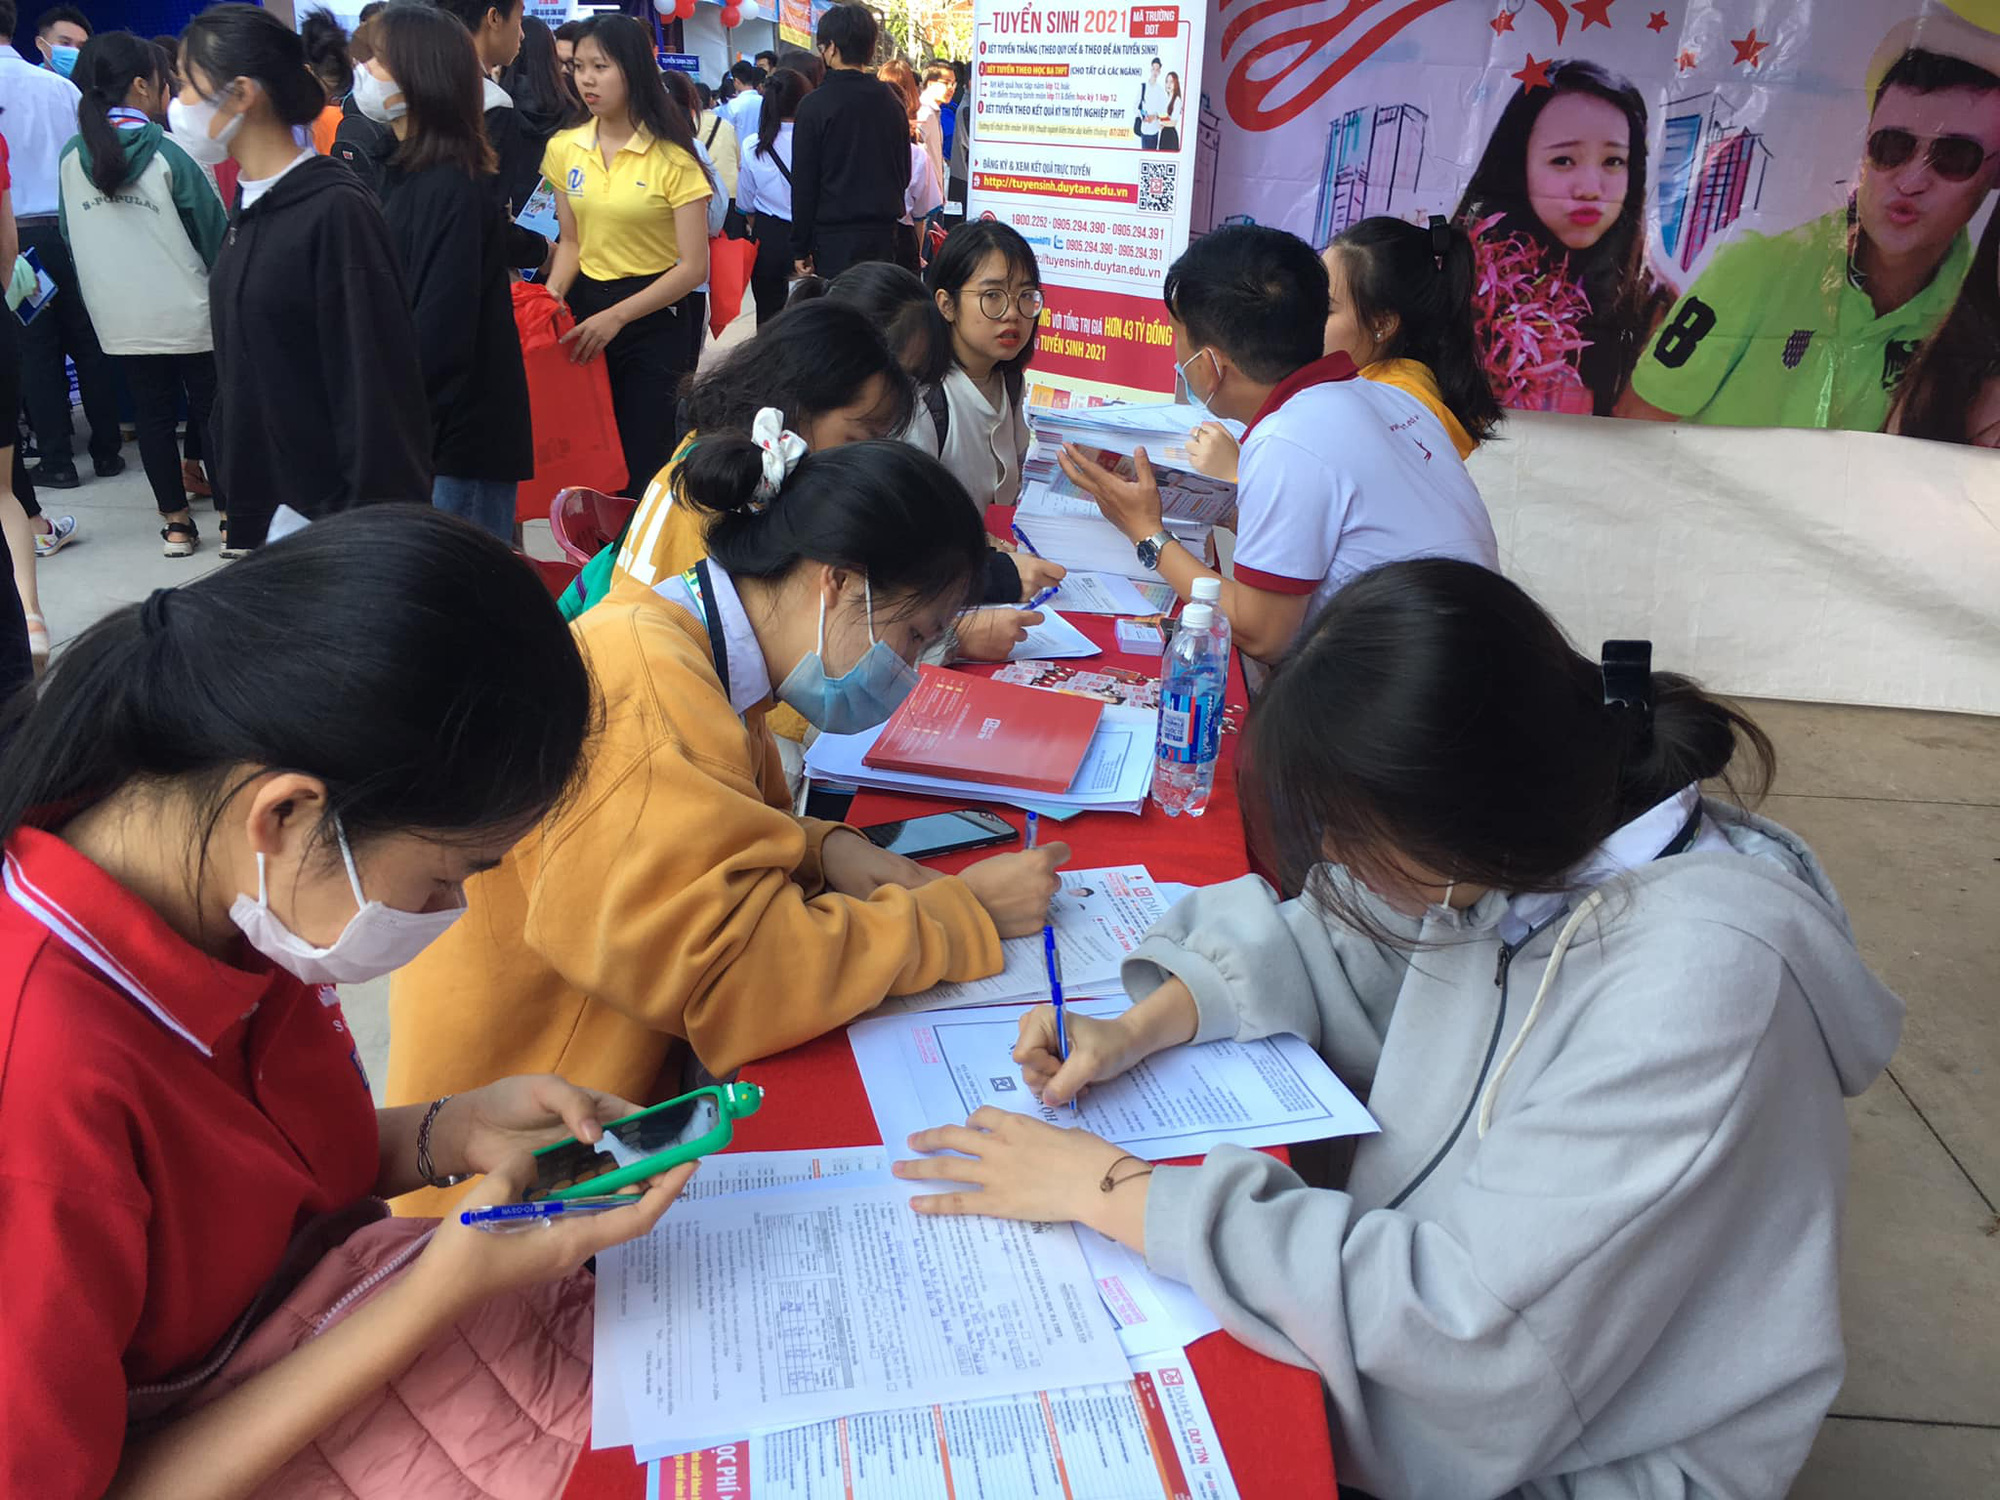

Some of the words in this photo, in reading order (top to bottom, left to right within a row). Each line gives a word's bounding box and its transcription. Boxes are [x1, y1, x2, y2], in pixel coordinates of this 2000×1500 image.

[993, 2, 1041, 33] TUYỂN
[1047, 11, 1079, 33] SINH
[1084, 9, 1126, 33] 2021
[1085, 45, 1102, 55] THEO
[1110, 94, 1118, 103] 12
[1015, 104, 1031, 115] THEO
[1110, 109, 1126, 119] THPT
[983, 158, 999, 170] ĐĂNG
[1009, 161, 1015, 171] &
[1016, 161, 1030, 172] XEM
[1031, 160, 1042, 173] KẾT
[984, 175, 1128, 197] http://tuyensinh.duytan.edu.vn
[1012, 213, 1048, 229] 1900.2252
[1053, 217, 1106, 234] 0905.294.390
[1112, 223, 1165, 241] 0905.294.391
[1066, 238, 1113, 256] 0905.294.390
[1118, 243, 1163, 262] 0905.294.391
[1034, 255, 1161, 278] p://tuyensinh.duytan.edu.vn
[1104, 316, 1123, 338] HƠN
[1123, 319, 1134, 341] 43
[1134, 315, 1146, 342] TỶ
[1146, 318, 1173, 346] ĐỒNG
[1040, 331, 1064, 354] TUYỂN
[1064, 338, 1085, 358] SINH
[1085, 342, 1106, 361] 2021
[711, 1444, 738, 1465] ỌC
[715, 1466, 743, 1493] PHÍ
